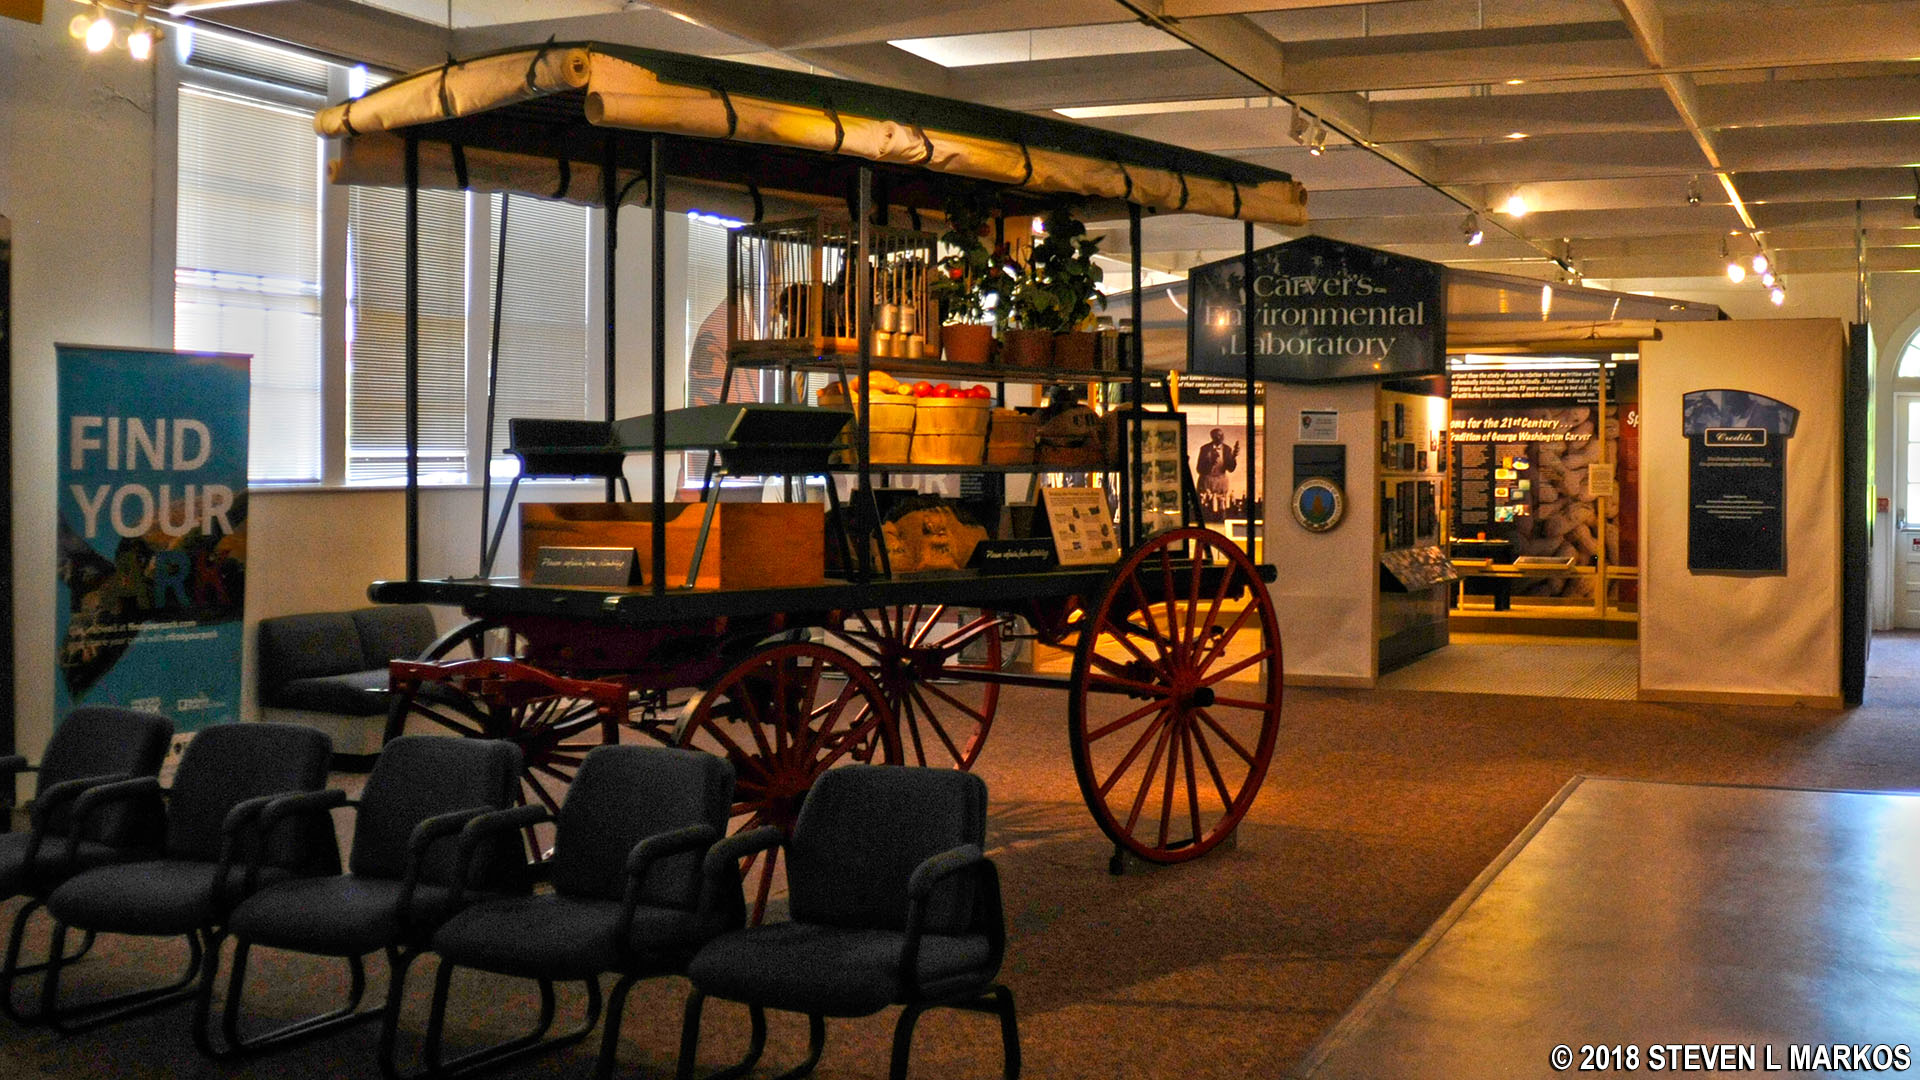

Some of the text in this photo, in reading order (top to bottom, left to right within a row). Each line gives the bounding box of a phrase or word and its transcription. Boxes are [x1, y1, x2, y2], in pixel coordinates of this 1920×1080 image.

[1252, 273, 1373, 297] Carver's
[1230, 333, 1396, 361] Laboratory
[1467, 417, 1482, 429] for
[1483, 417, 1499, 429] the
[69, 416, 212, 471] FIND
[1482, 432, 1492, 442] of
[1492, 432, 1518, 443] George
[1518, 432, 1564, 443] Washington
[1565, 432, 1592, 442] Carver
[69, 483, 235, 538] YOUR
